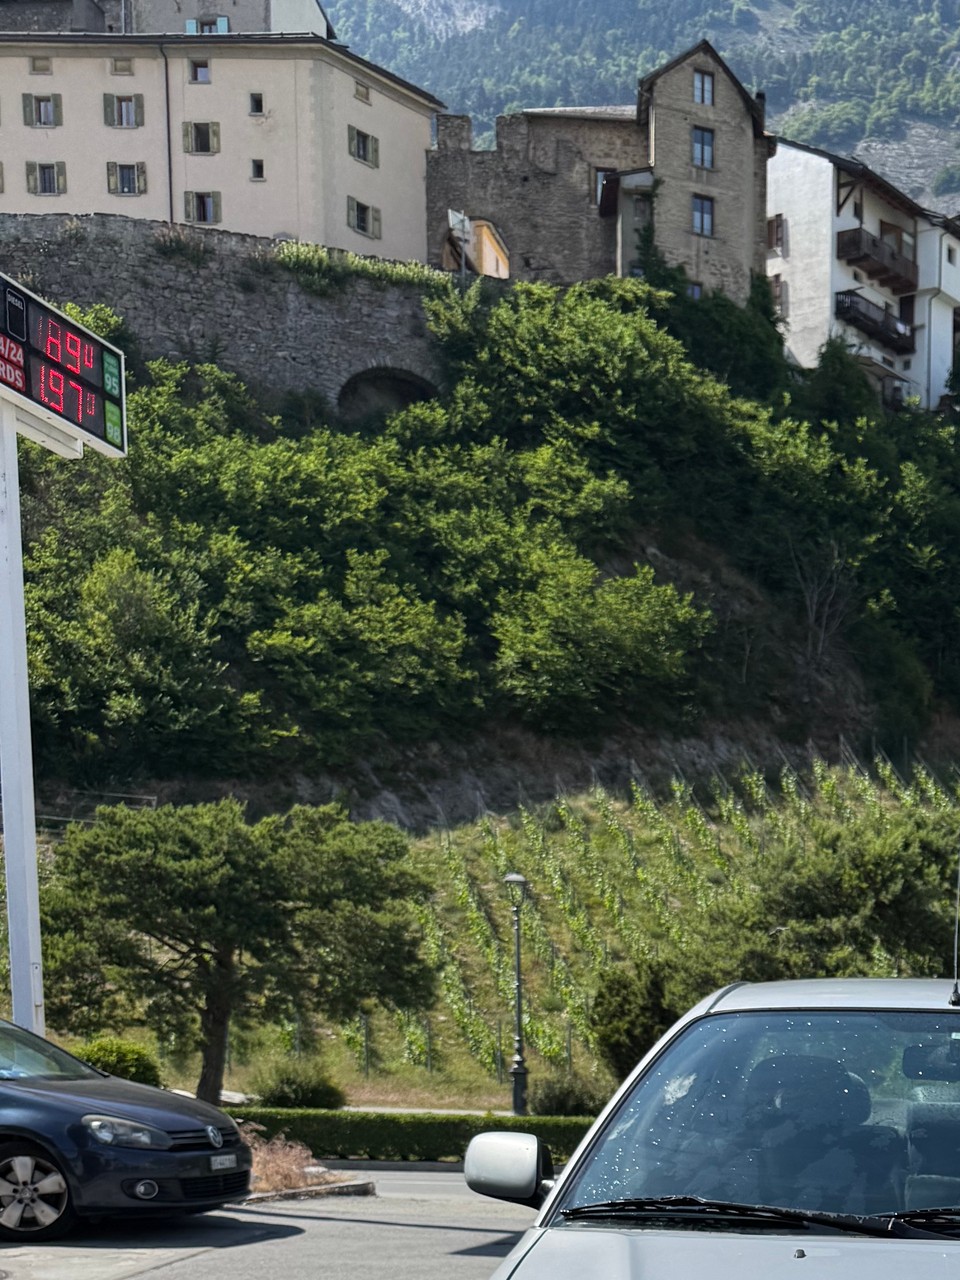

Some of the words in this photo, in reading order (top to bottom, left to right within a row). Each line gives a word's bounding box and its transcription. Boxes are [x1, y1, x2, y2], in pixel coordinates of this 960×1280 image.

[7, 294, 24, 310] DIESEL
[104, 373, 120, 395] 95
[106, 423, 121, 443] 98
